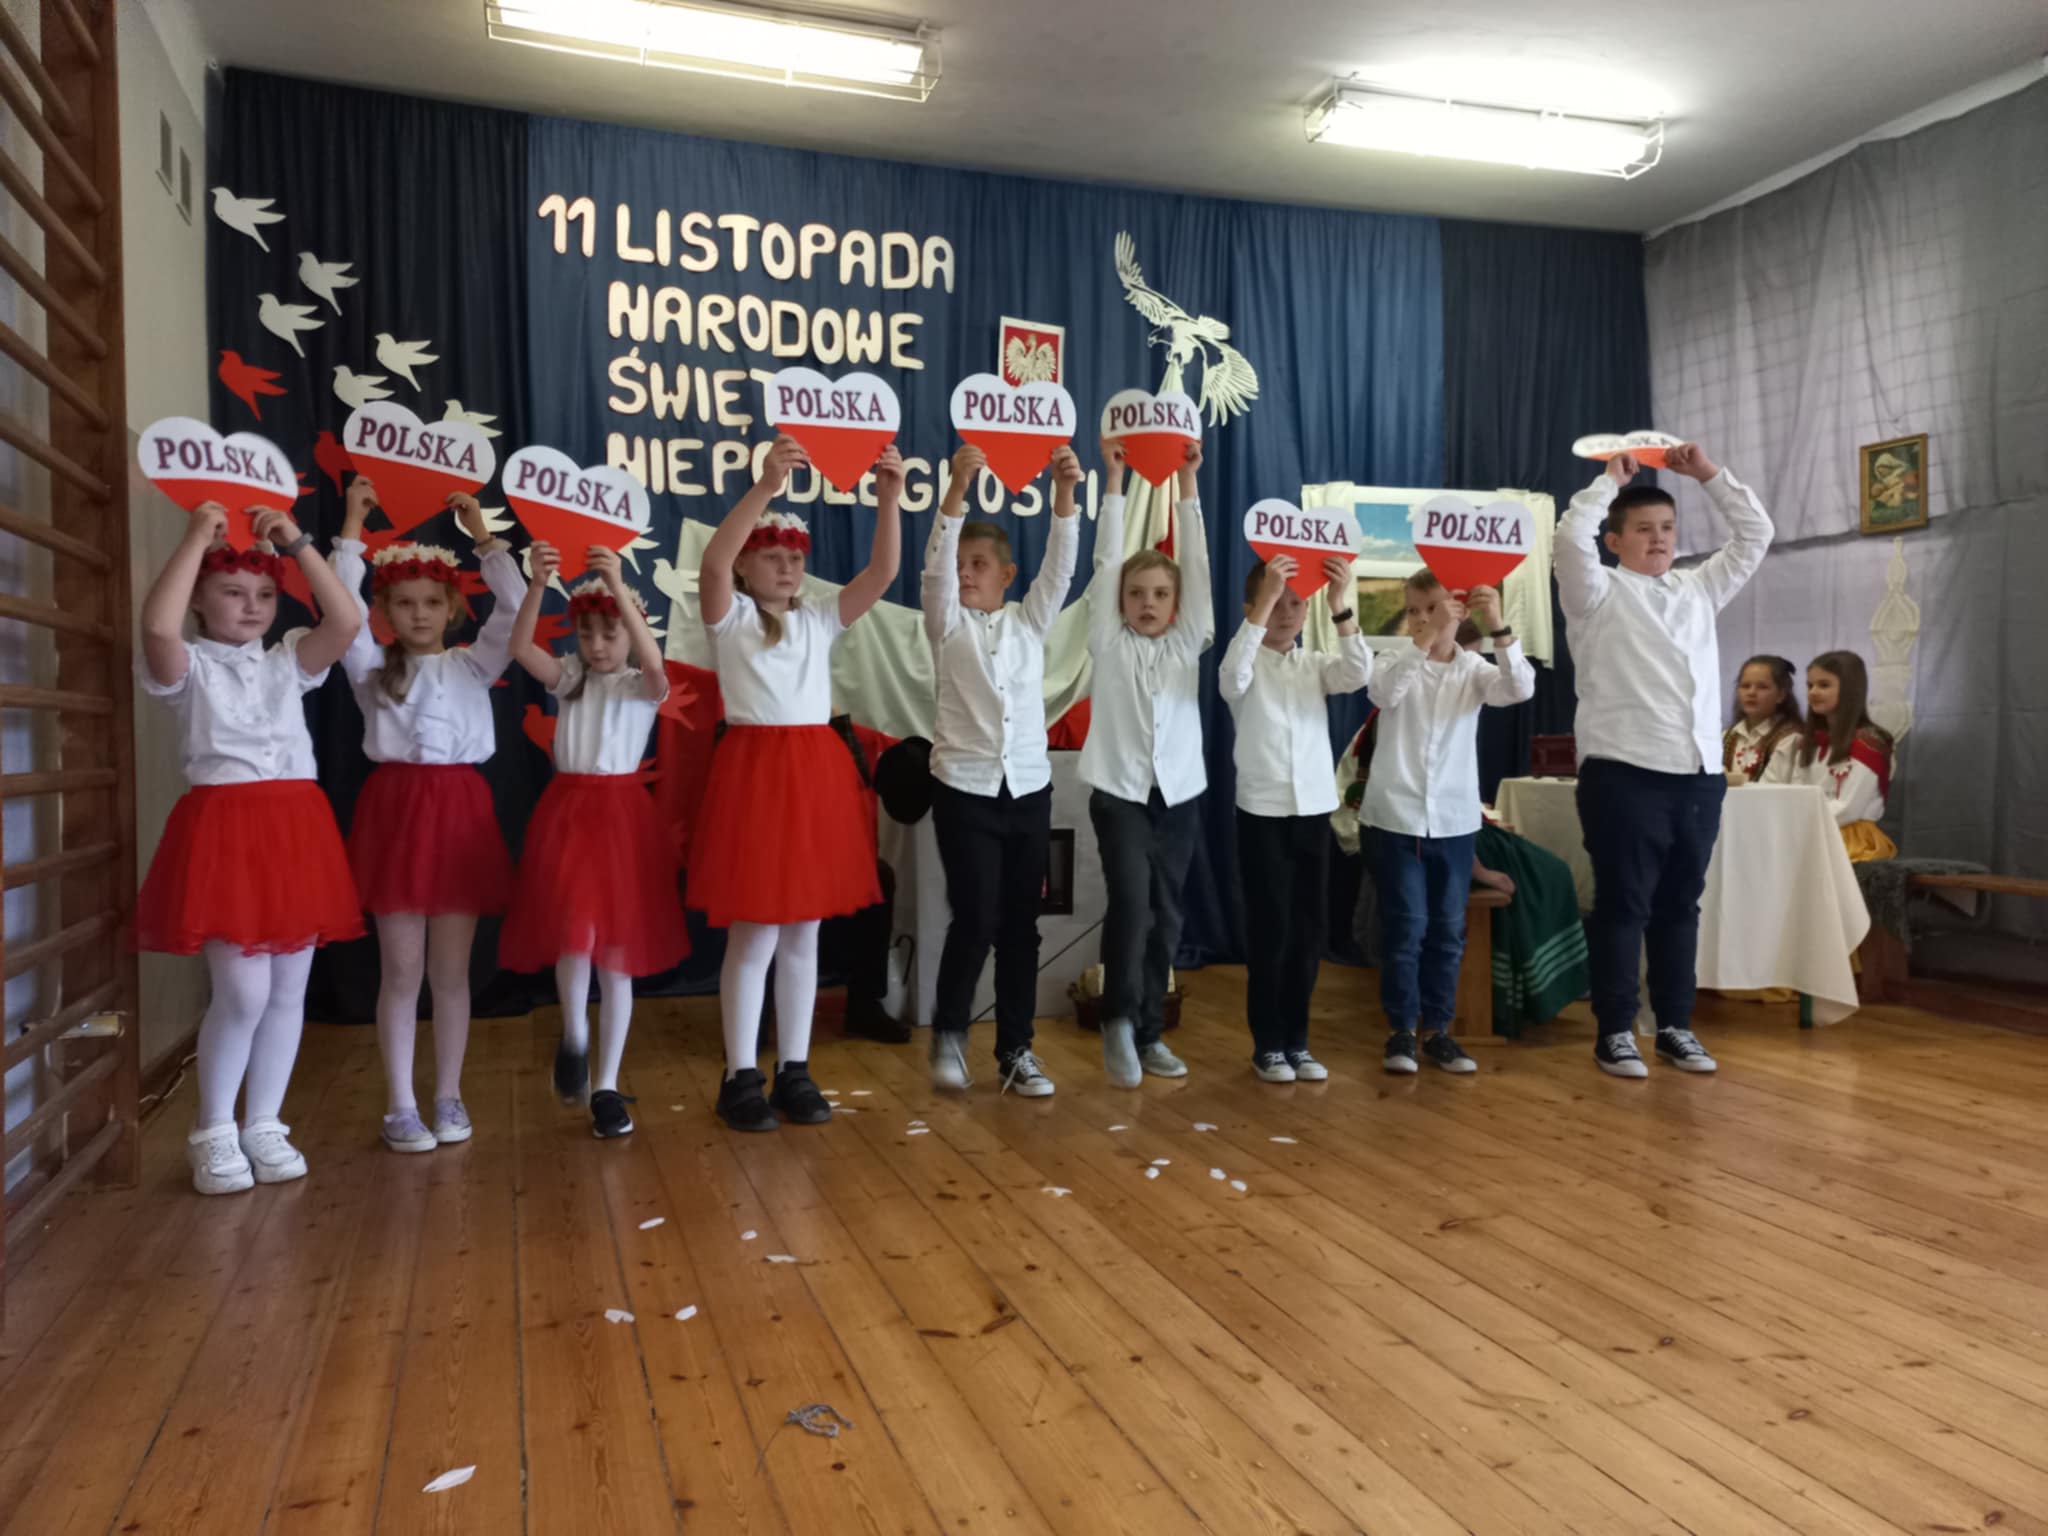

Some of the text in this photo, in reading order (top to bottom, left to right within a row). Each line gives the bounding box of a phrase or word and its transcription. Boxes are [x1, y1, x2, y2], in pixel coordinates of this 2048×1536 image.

[538, 193, 956, 294] 11 LISTOPADA
[607, 281, 926, 370] NARODOWE
[607, 346, 776, 436] ŚWIĘT
[776, 385, 887, 423] POLSKA
[962, 390, 1065, 427] POLSKA
[1109, 403, 1195, 433] POLSKA
[153, 436, 284, 487] POLSKA
[355, 415, 478, 474] POLSKA
[515, 458, 634, 522] POLSKA
[1254, 510, 1349, 547] POLSKA
[1423, 509, 1523, 547] POLSKA
